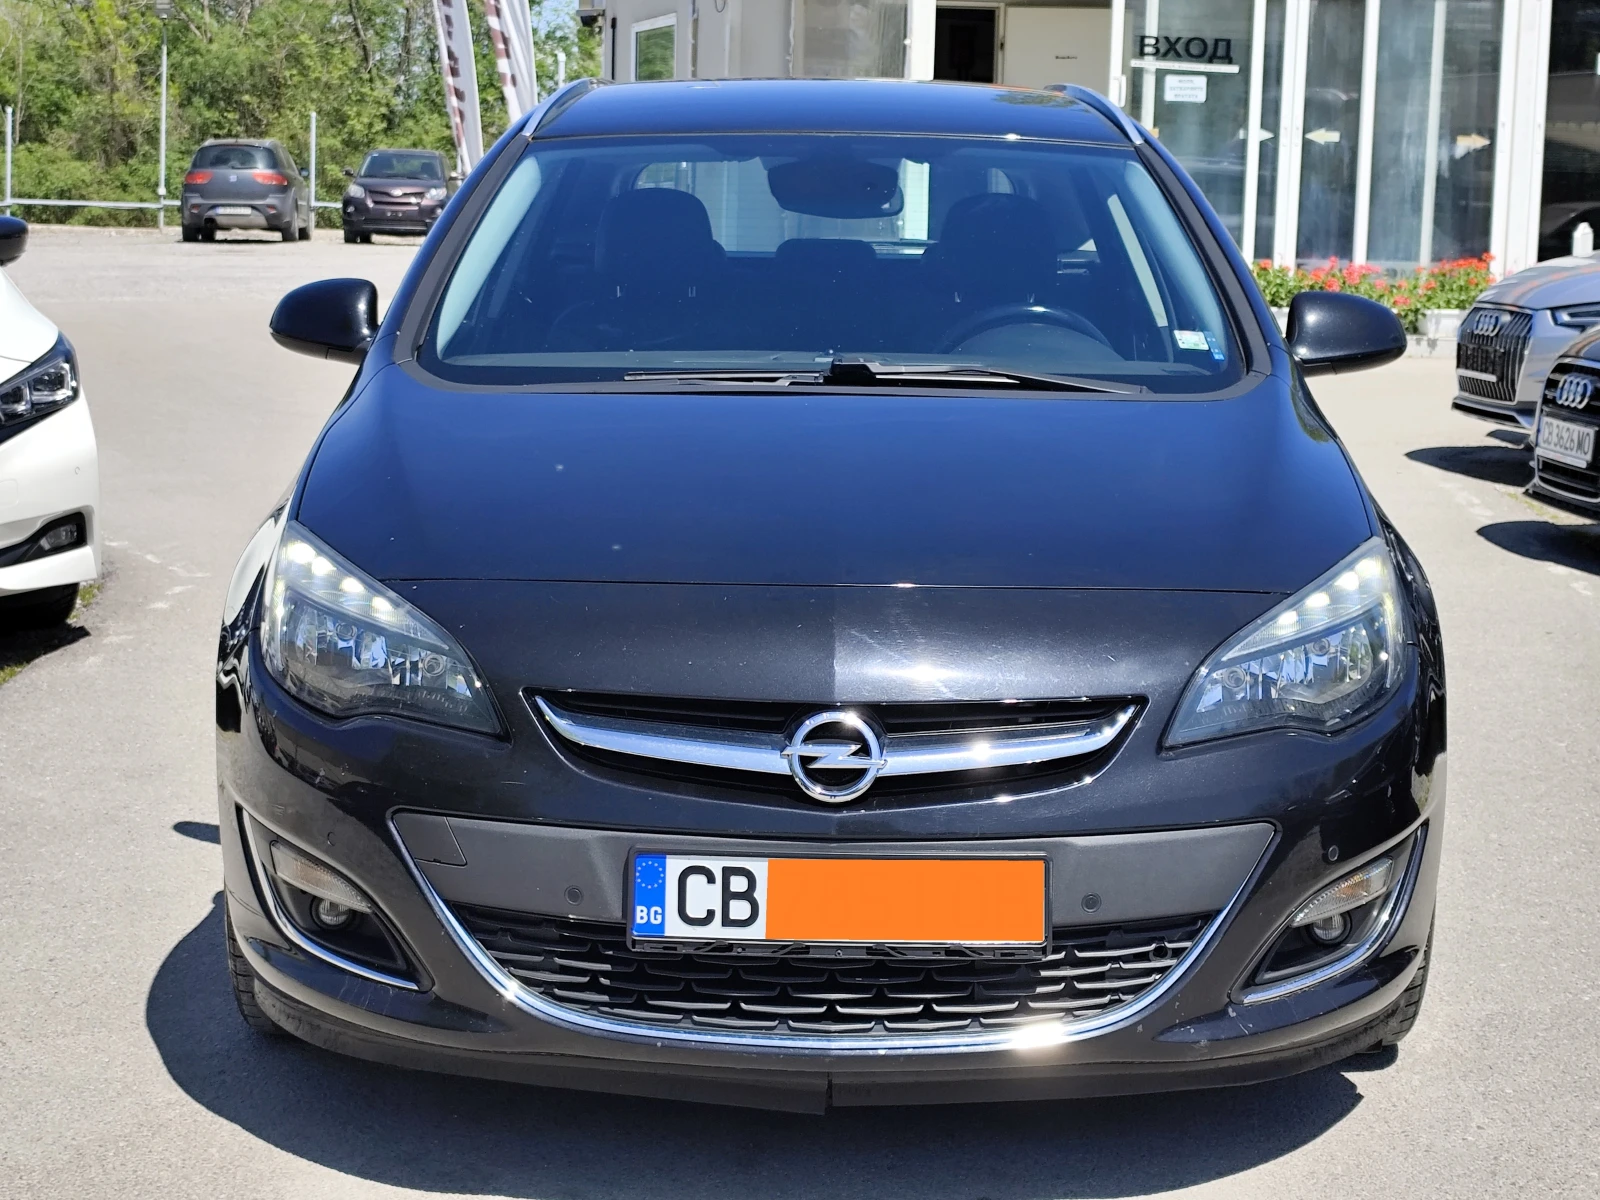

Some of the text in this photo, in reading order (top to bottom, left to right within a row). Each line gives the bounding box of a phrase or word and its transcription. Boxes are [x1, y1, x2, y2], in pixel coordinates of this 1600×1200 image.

[1139, 35, 1233, 64] ВХОД
[1553, 424, 1575, 451] 3626
[677, 864, 760, 928] CB
[635, 905, 663, 925] BG
